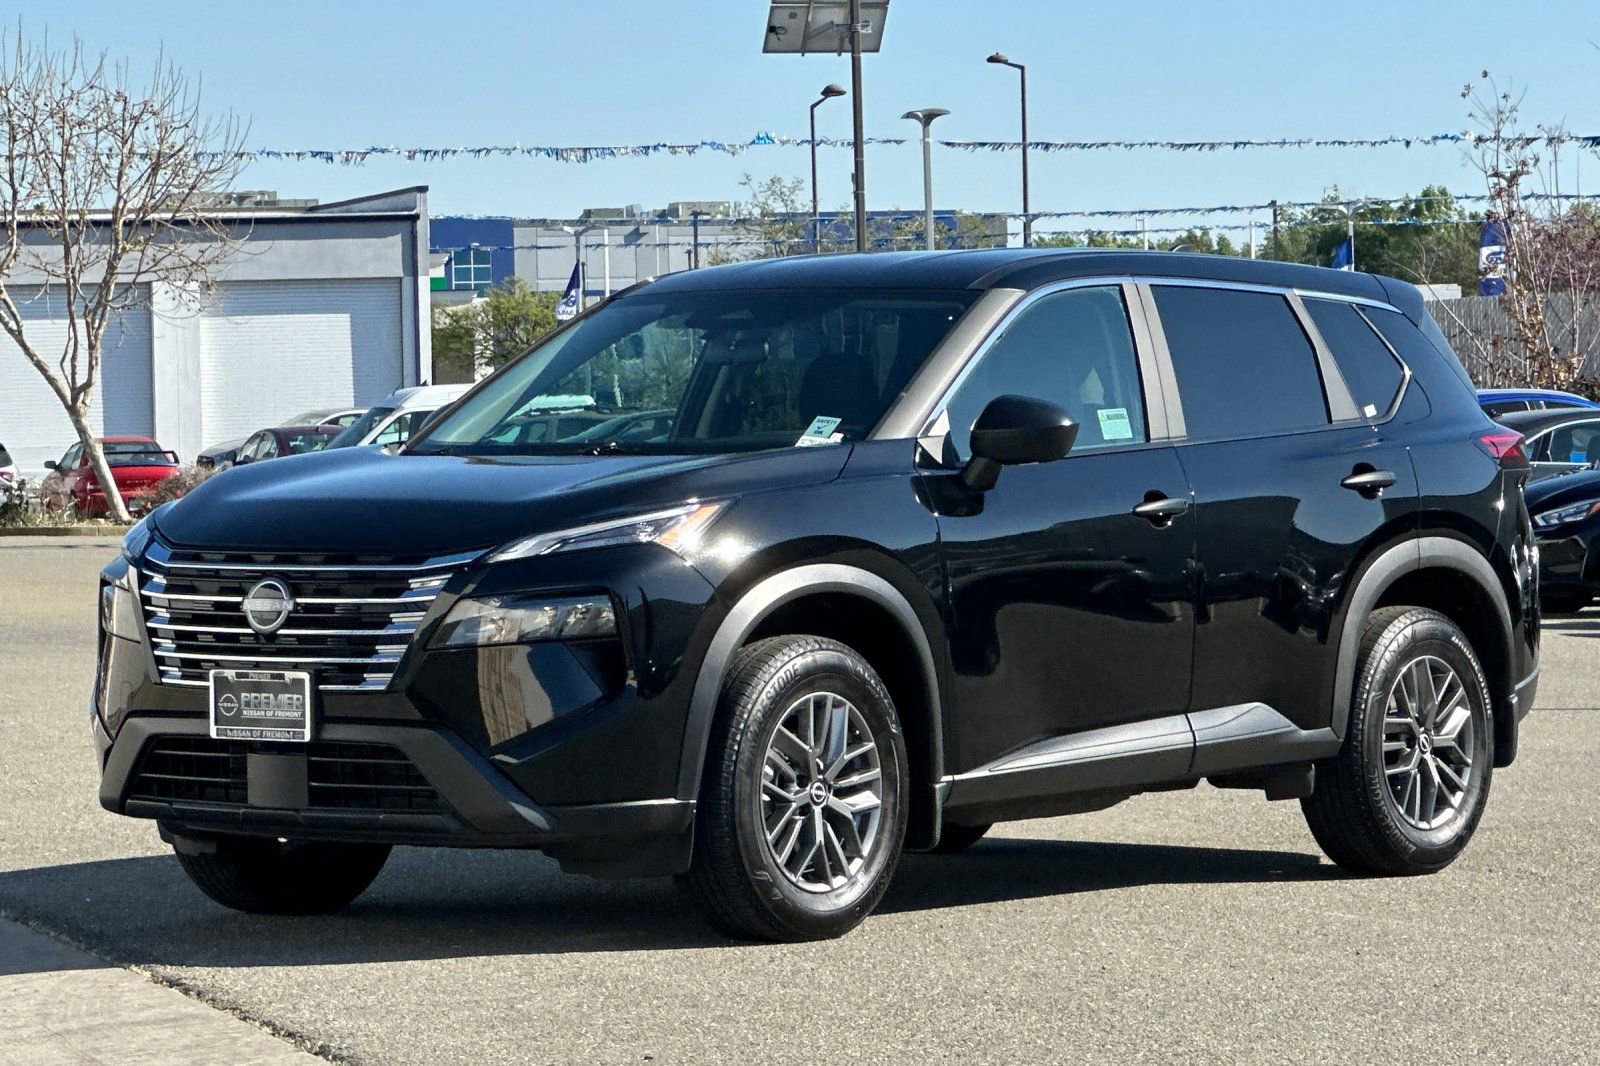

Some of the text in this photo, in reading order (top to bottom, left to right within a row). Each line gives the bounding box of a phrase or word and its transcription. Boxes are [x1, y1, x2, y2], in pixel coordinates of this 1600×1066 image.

[244, 598, 293, 611] NISSAN
[241, 692, 303, 709] PREMIER
[265, 709, 274, 717] OF
[226, 729, 294, 739] NISSAN OF FREMONT
